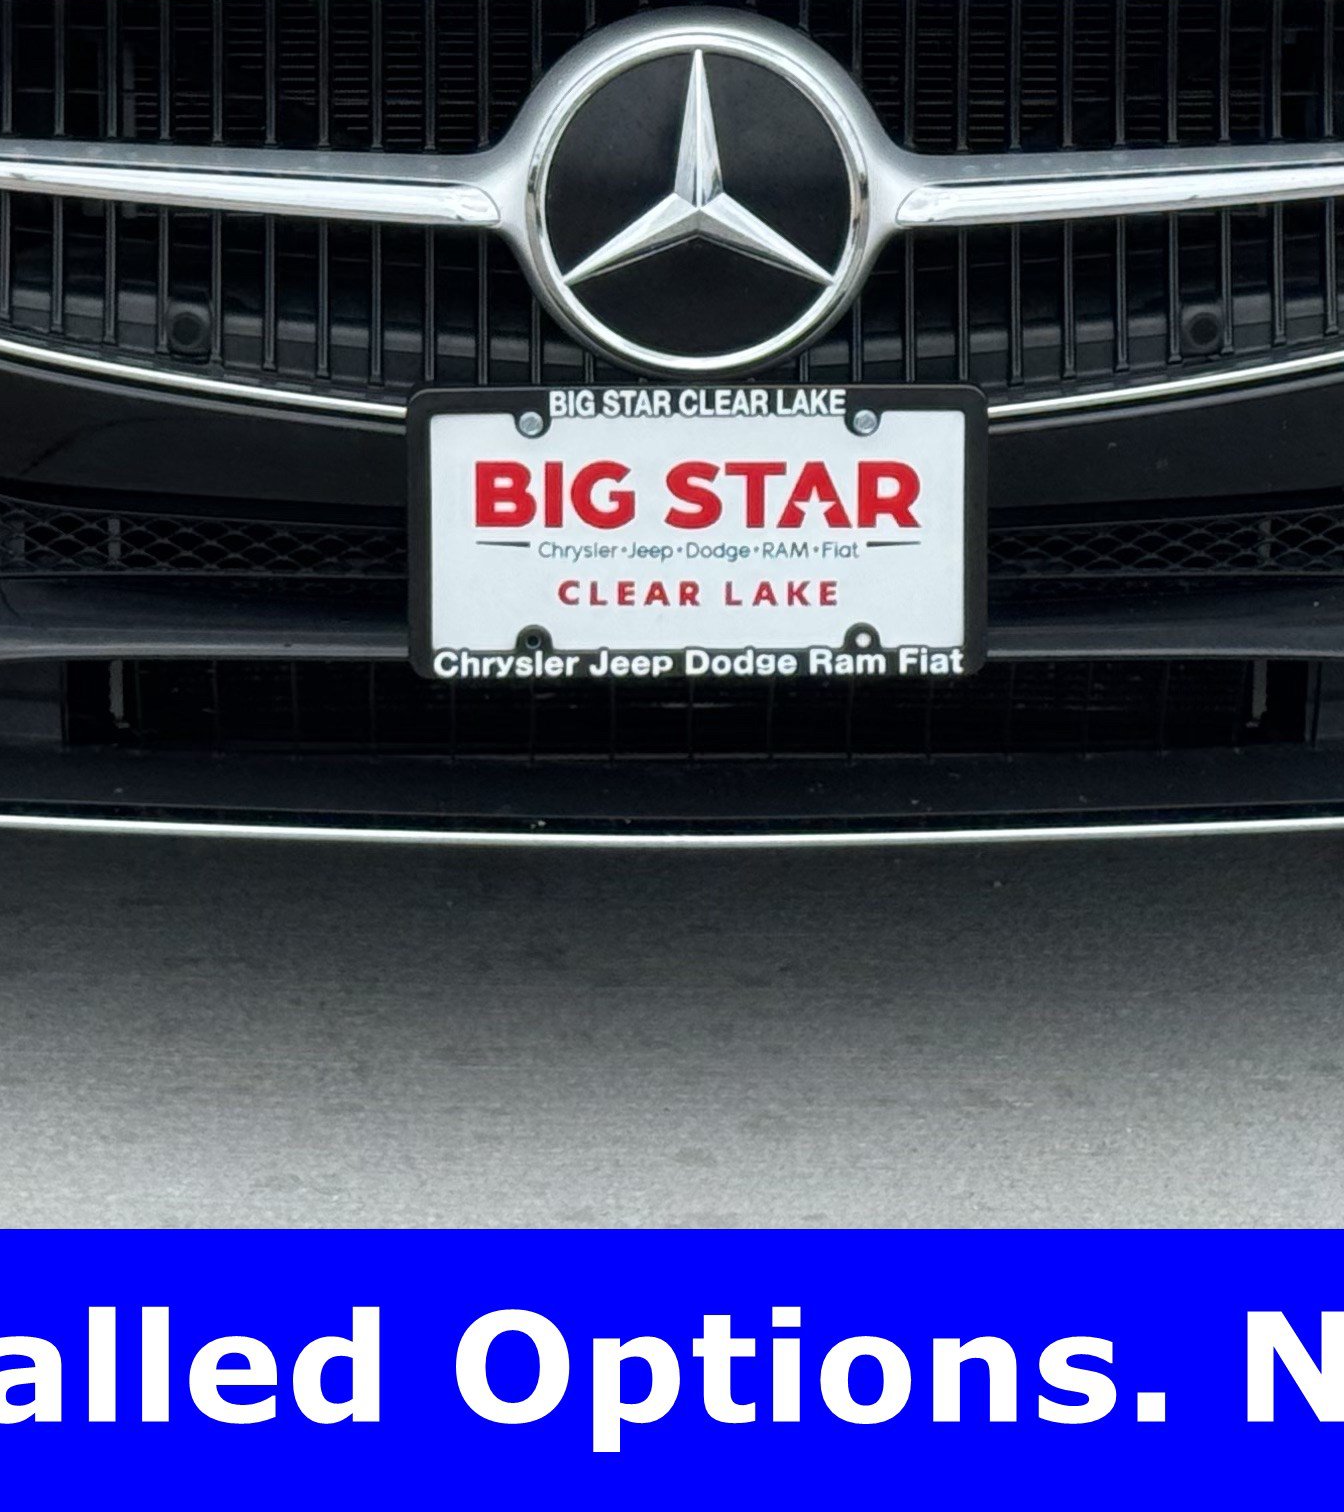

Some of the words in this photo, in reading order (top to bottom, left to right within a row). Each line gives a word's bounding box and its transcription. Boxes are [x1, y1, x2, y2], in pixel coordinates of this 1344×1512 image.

[549, 389, 596, 417] BIG
[602, 389, 672, 417] STAR
[678, 389, 769, 417] CLEAR
[776, 389, 847, 416] LAKE
[474, 460, 636, 530] BIG
[665, 460, 921, 530] STAR
[557, 579, 701, 607] CLEAR
[724, 579, 838, 607] LAKE
[433, 649, 580, 679] Chrysler
[589, 649, 674, 678] Jeep
[685, 648, 798, 677] Dodge
[809, 646, 887, 675] Ram
[899, 647, 964, 675] Fiat
